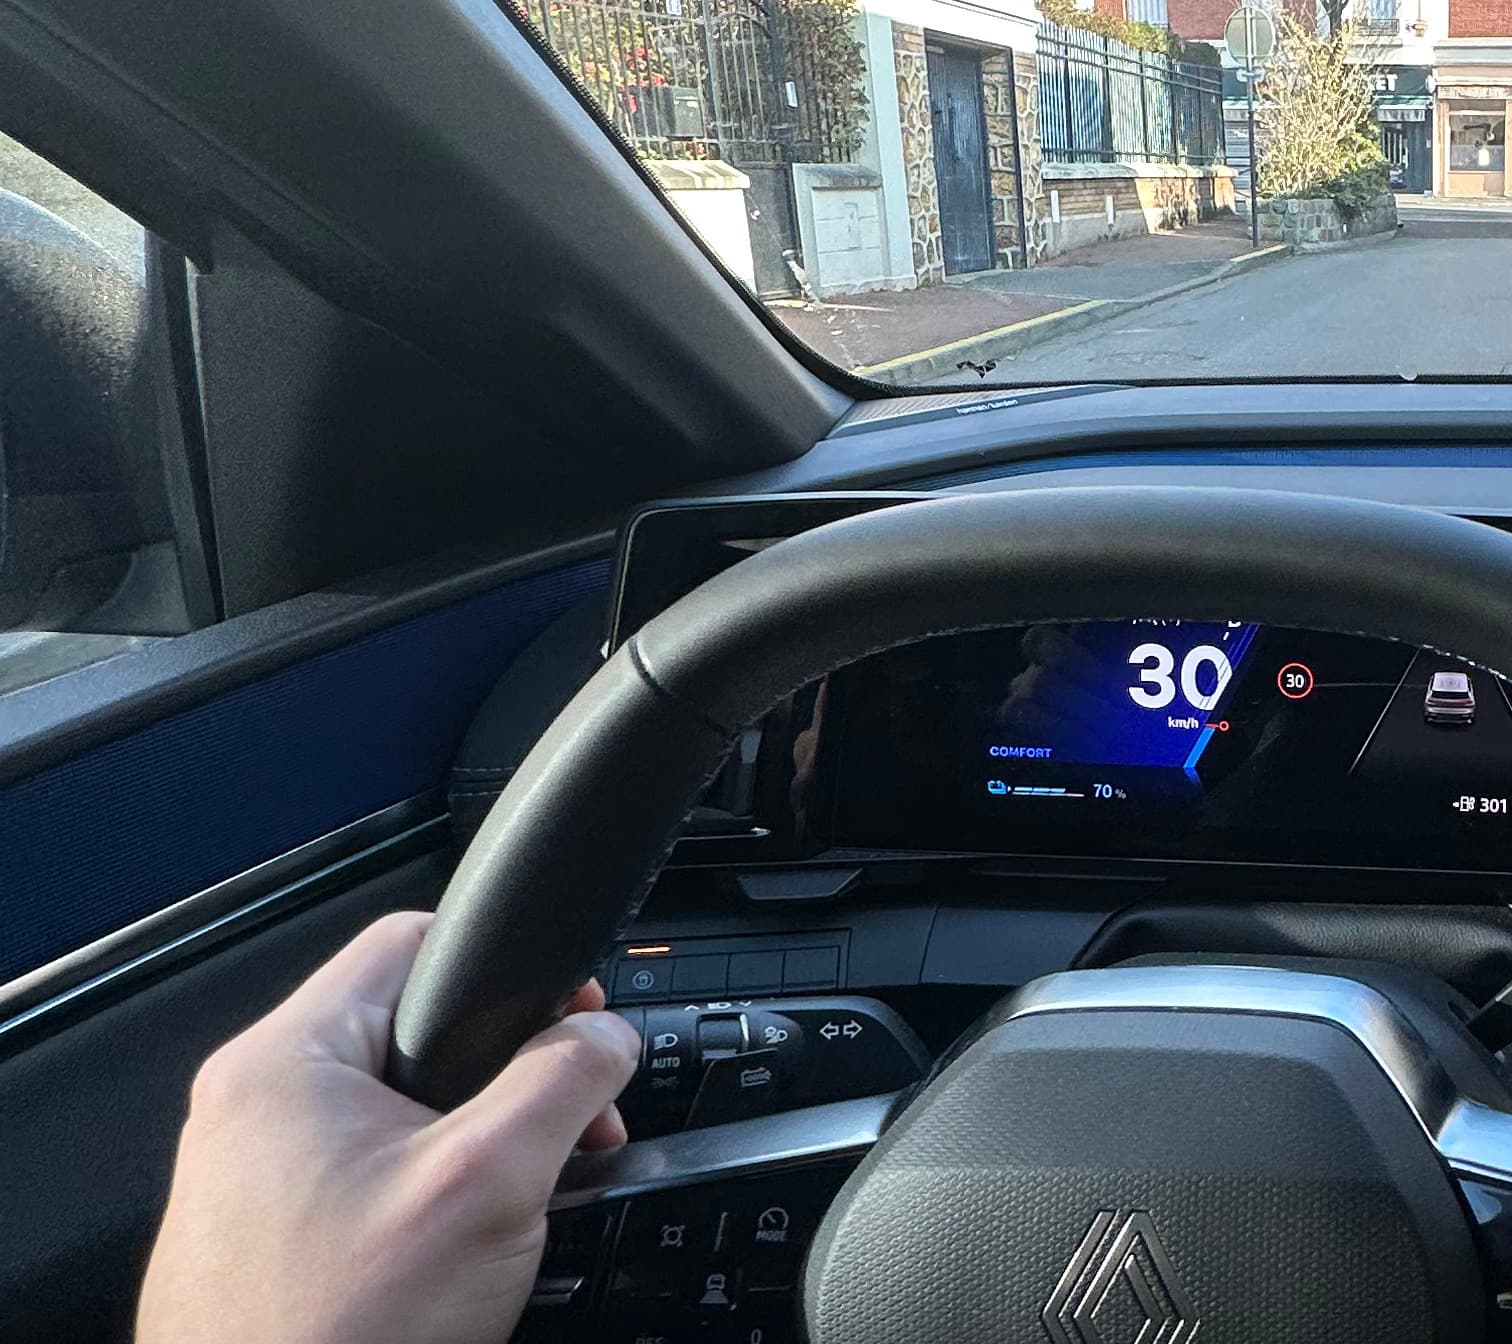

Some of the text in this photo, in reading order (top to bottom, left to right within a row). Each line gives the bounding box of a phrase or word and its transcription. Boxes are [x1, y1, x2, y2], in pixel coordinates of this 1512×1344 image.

[1127, 643, 1232, 711] 30
[1286, 674, 1304, 689] 30
[1167, 715, 1199, 730] km/h
[989, 746, 1053, 758] COMFORT
[1093, 783, 1127, 799] 70 %
[1479, 797, 1508, 814] 301
[651, 1056, 680, 1069] AUTO
[755, 1230, 787, 1242] MODE
